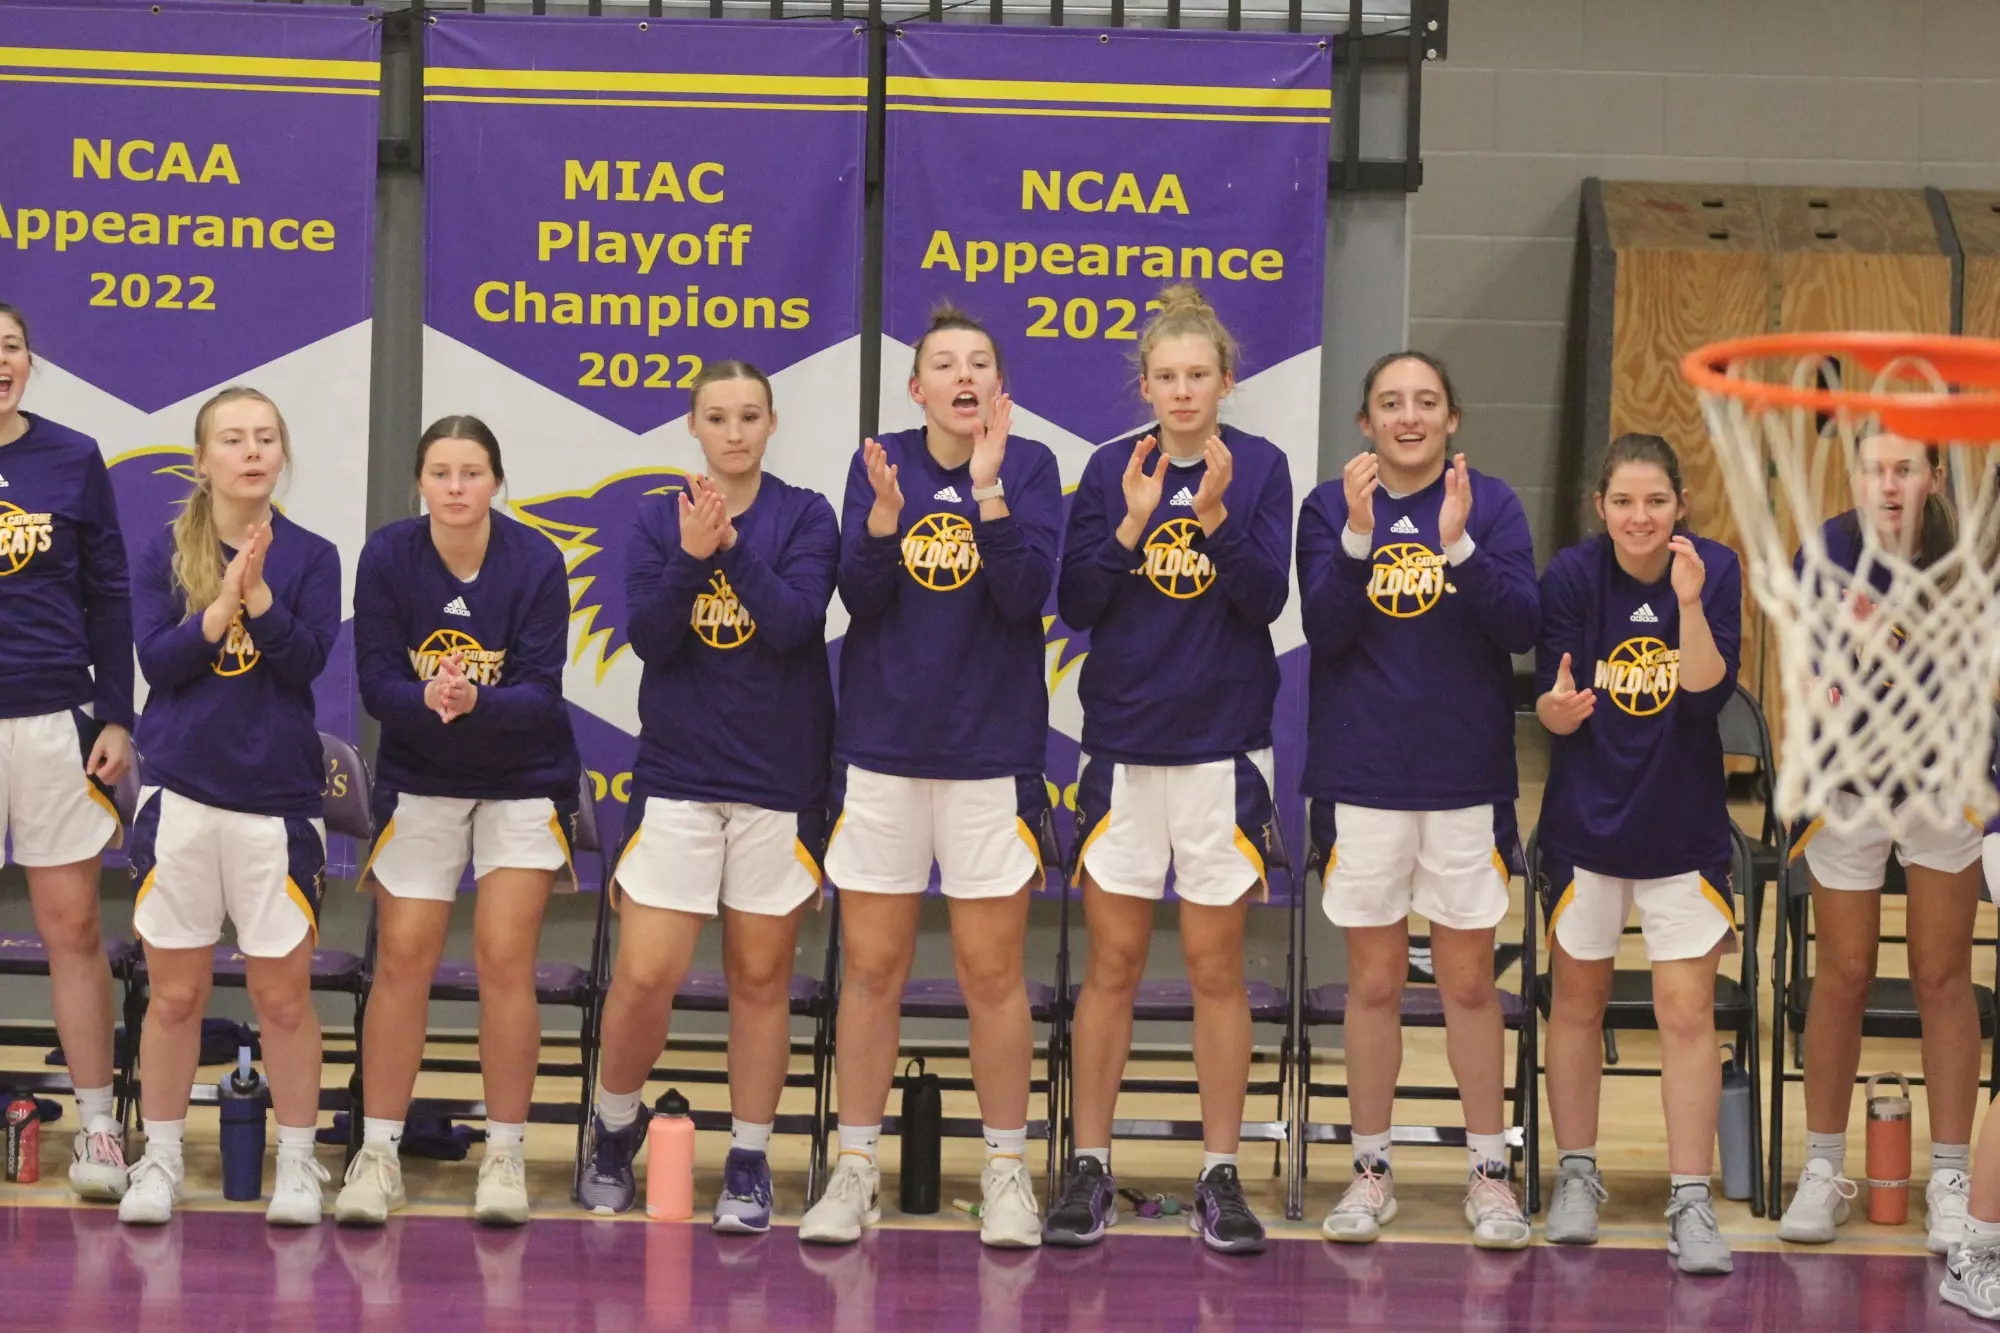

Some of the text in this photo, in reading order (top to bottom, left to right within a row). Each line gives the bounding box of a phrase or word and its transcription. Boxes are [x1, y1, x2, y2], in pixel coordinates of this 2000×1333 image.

[73, 138, 240, 183] NCAA
[564, 159, 727, 203] MIAC
[1023, 170, 1189, 215] NCAA
[539, 221, 753, 274] Playoff
[922, 230, 1284, 285] Appearance
[89, 272, 216, 311] 2022
[474, 280, 811, 337] Champions
[578, 351, 703, 389] 2022
[1169, 498, 1194, 506] adida
[1390, 526, 1420, 534] adidas
[443, 606, 471, 617] adidas
[1629, 615, 1659, 623] adidas
[1593, 659, 1681, 695] WILDCAT
